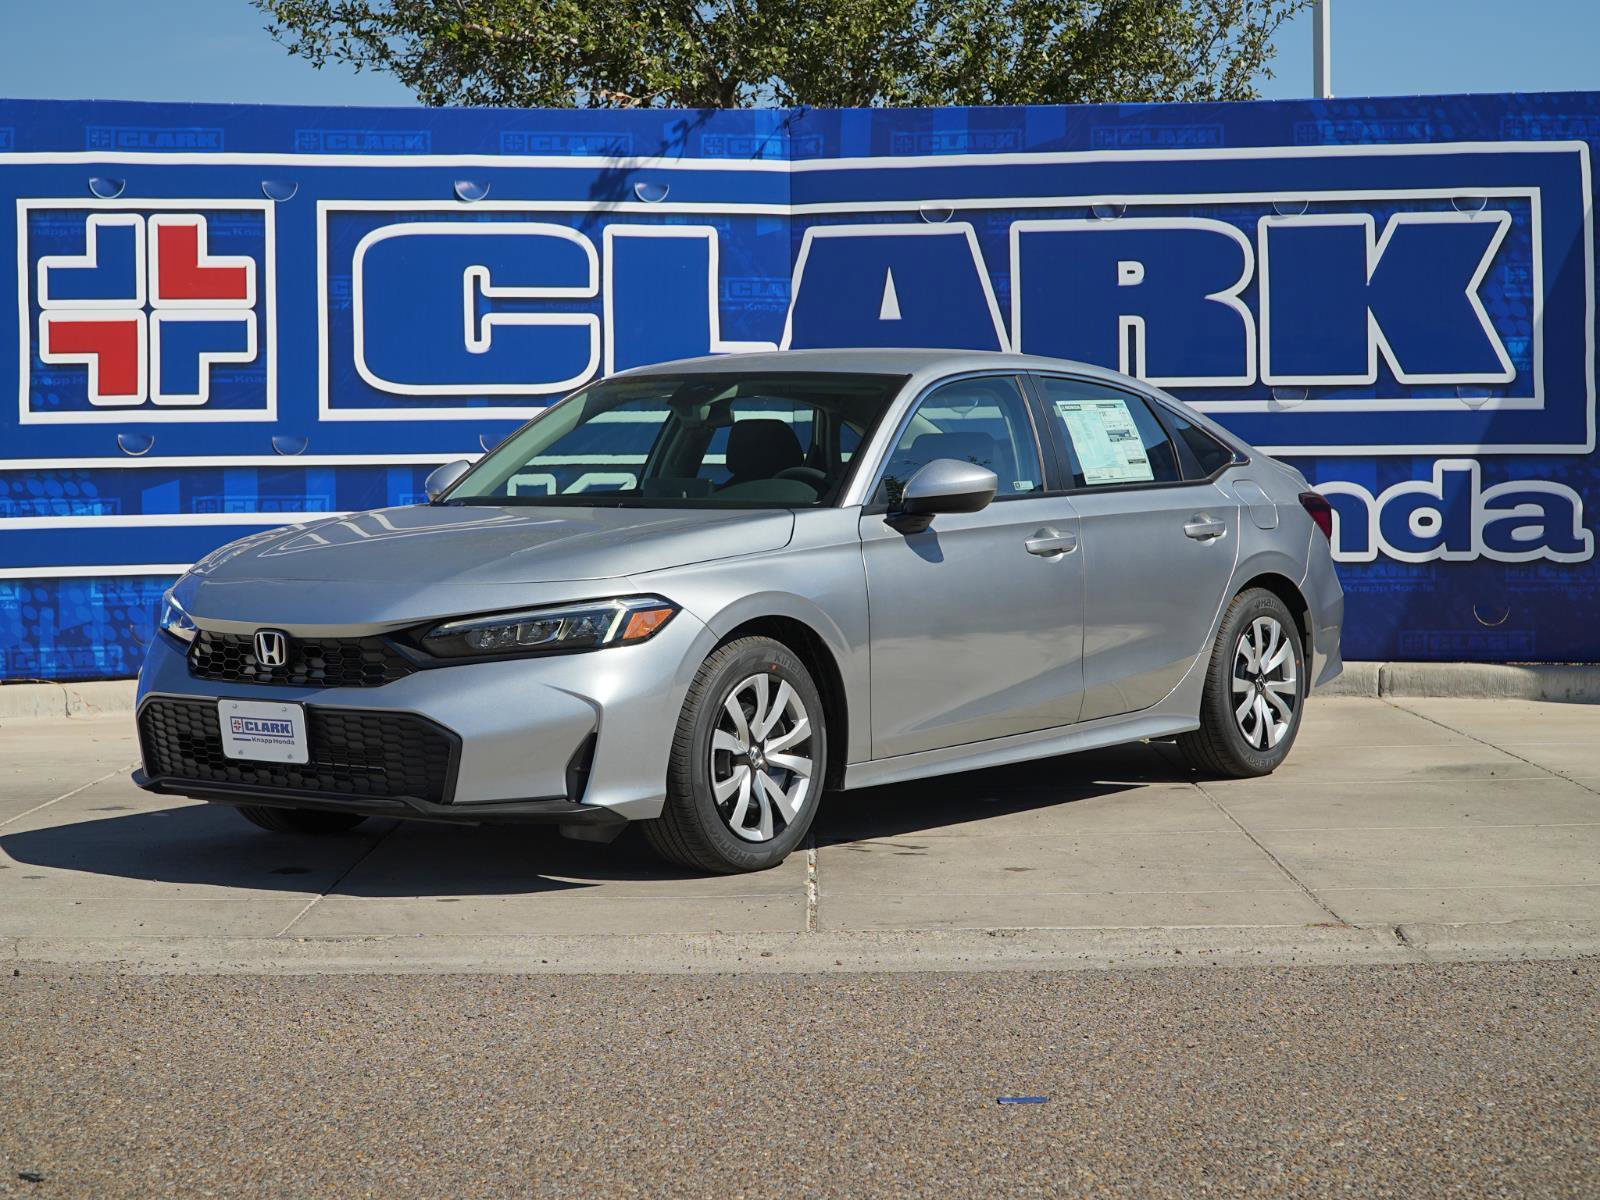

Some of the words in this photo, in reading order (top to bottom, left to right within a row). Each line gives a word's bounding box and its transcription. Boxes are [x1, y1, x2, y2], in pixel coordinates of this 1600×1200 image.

[117, 131, 218, 148] CLARK
[325, 135, 425, 150] CLARK
[351, 209, 1517, 396] CLARK
[244, 720, 291, 735] CLARK
[251, 736, 273, 745] Knapp
[273, 738, 295, 746] Honda
